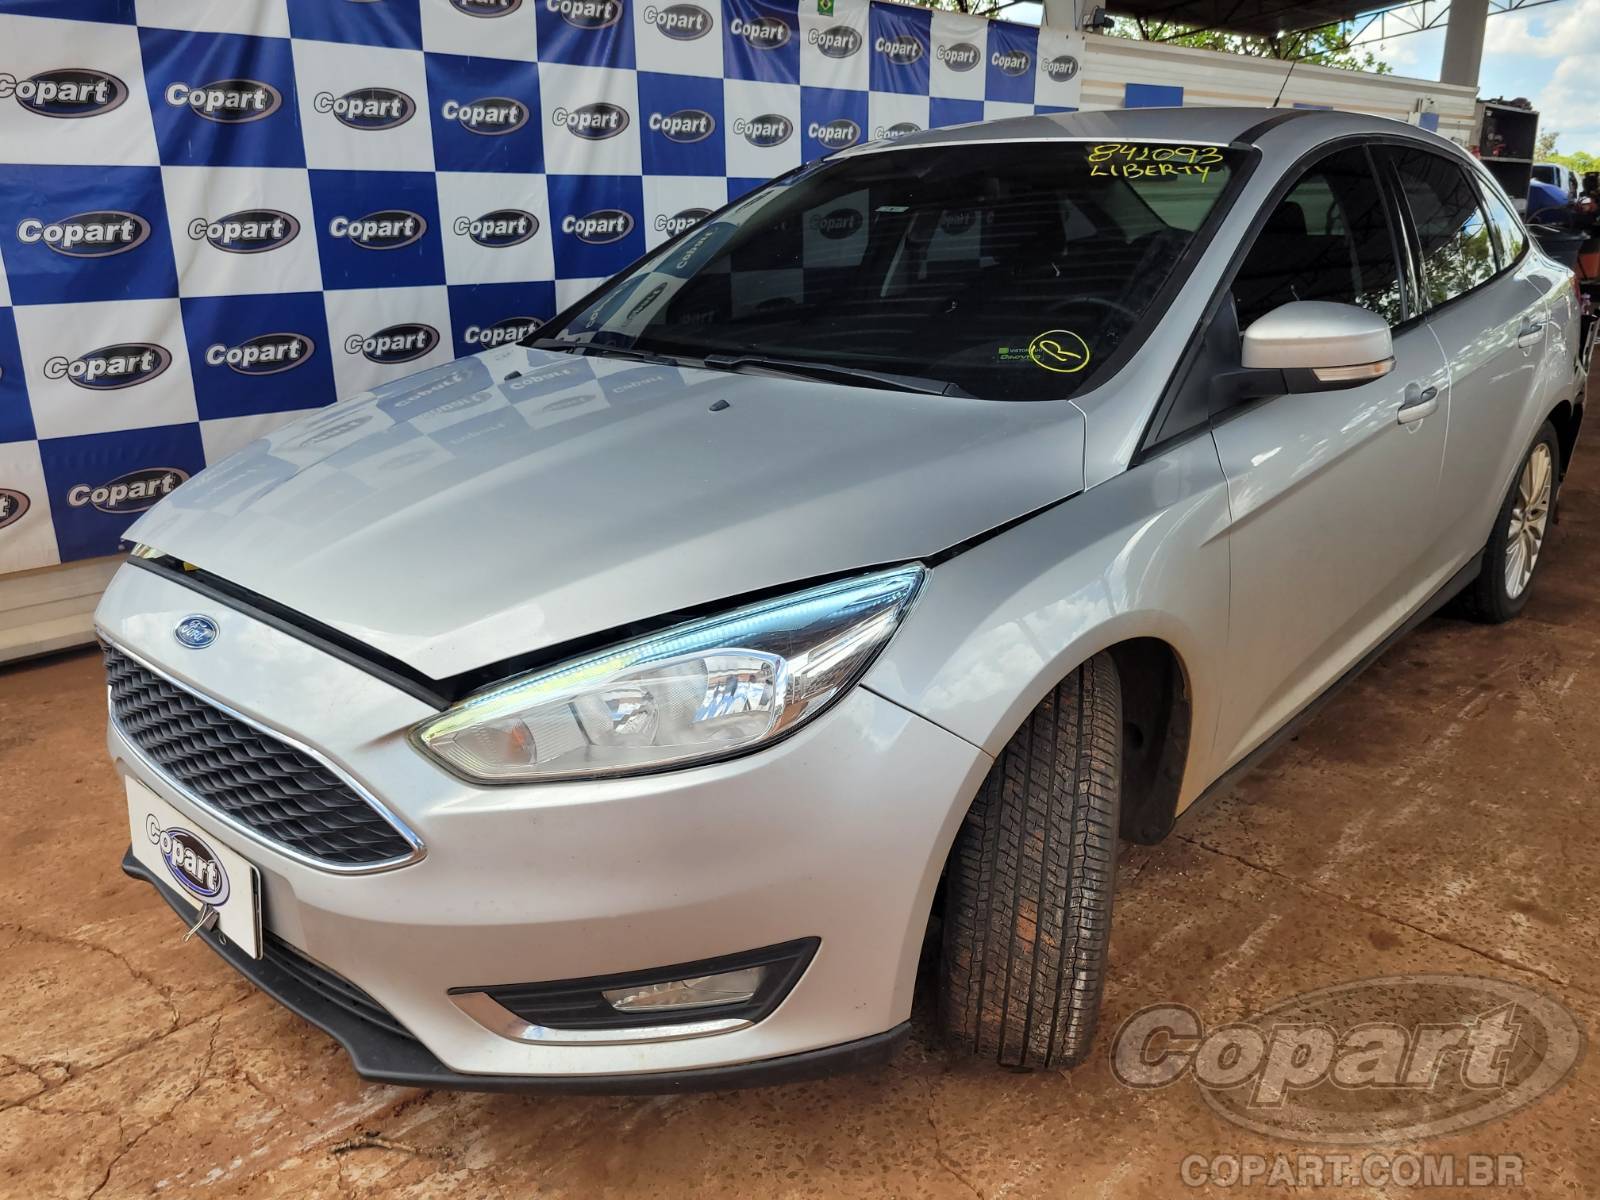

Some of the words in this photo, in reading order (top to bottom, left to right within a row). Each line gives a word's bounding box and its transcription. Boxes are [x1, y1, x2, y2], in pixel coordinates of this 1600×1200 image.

[547, 0, 612, 18] Copart
[644, 6, 703, 33] Copart
[731, 19, 784, 42] Copart
[808, 28, 854, 49] Copart
[875, 37, 918, 58] Copart
[936, 46, 975, 64] Copart
[991, 52, 1027, 69] Copart
[1041, 58, 1073, 76] Copart
[165, 82, 267, 112] Copart
[314, 92, 403, 119] Copart
[442, 101, 519, 125] Copart
[552, 107, 619, 130] Copart
[649, 113, 707, 135] Copart
[733, 118, 785, 137] Copart
[808, 123, 854, 142] Copart
[1090, 164, 1210, 183] LIBERTY
[16, 217, 137, 248] Copart
[188, 216, 285, 246] Copart
[329, 215, 415, 243] Copart
[453, 216, 527, 241] Copart
[561, 215, 625, 237] Copart
[205, 337, 302, 366] Copart
[345, 330, 429, 356] Copart
[43, 350, 155, 382] Copart
[67, 471, 176, 507] Copart
[145, 812, 221, 894] Copart
